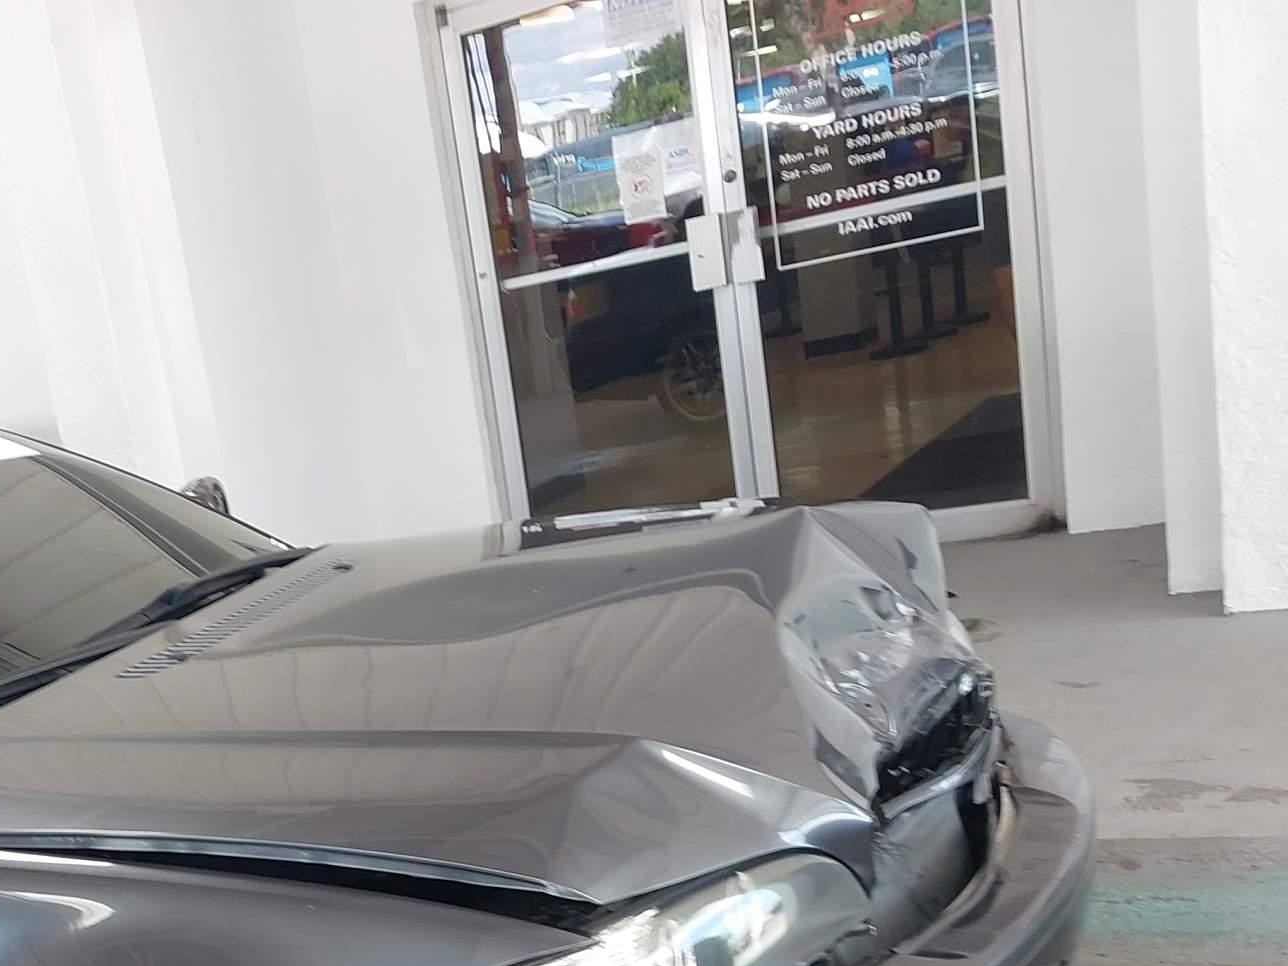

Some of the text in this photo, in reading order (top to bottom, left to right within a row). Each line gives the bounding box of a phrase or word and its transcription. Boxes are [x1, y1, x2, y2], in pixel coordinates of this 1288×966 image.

[800, 31, 922, 74] OFFICE HOURS
[772, 85, 798, 99] Mon
[807, 76, 824, 91] Fri
[774, 100, 794, 114] Sat
[803, 94, 826, 108] Sun
[812, 103, 922, 140] YARD HOURS
[778, 151, 805, 166] Mon
[814, 143, 829, 158] Fri
[845, 134, 872, 150] 8:00
[780, 167, 801, 182] Sat
[810, 161, 833, 176] Sun
[846, 147, 887, 167] Closed
[805, 168, 942, 210] NO PARTS SOLD
[837, 210, 913, 236] IAAI.com
